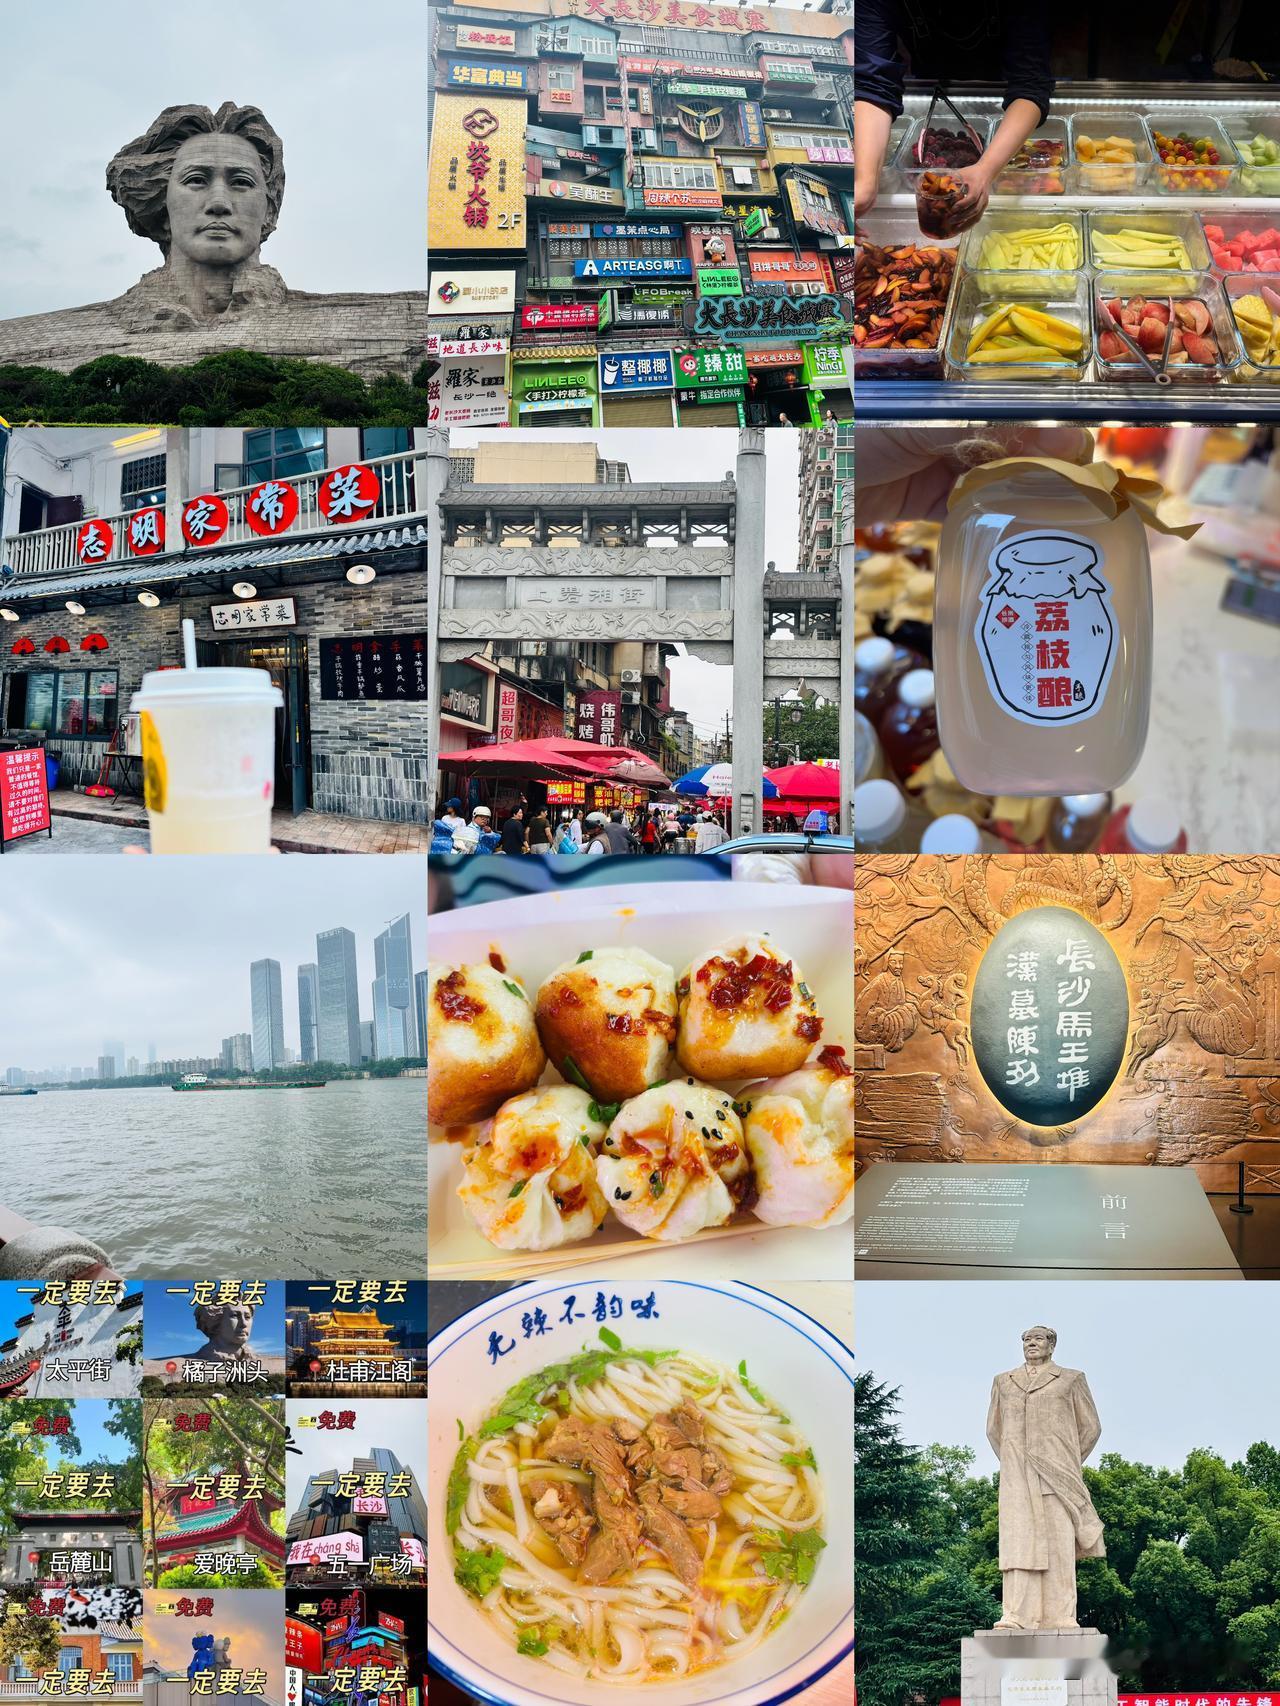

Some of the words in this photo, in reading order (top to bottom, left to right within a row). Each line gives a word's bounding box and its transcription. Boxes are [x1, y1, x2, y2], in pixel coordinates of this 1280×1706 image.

[453, 65, 523, 88] 华富典当
[497, 212, 521, 229] 2F
[634, 288, 694, 296] UFOBreak
[704, 353, 743, 373] 臻甜
[814, 347, 840, 361] 柠季
[621, 358, 667, 376] 整椰椰
[680, 391, 696, 401] 蒙牛
[700, 388, 741, 400] 指定合作伙伴
[80, 466, 375, 560] 志明家常菜
[527, 586, 645, 604] 上碧湘街
[1034, 601, 1072, 708] 荔枝酿
[501, 690, 515, 743] 超哥夜
[579, 703, 595, 739] 烧烤
[6, 752, 39, 765] 温馨提示
[1100, 1194, 1130, 1239] 前言
[356, 1500, 383, 1513] 长沙
[290, 1542, 313, 1560] 我在
[289, 1669, 297, 1691] 中国人
